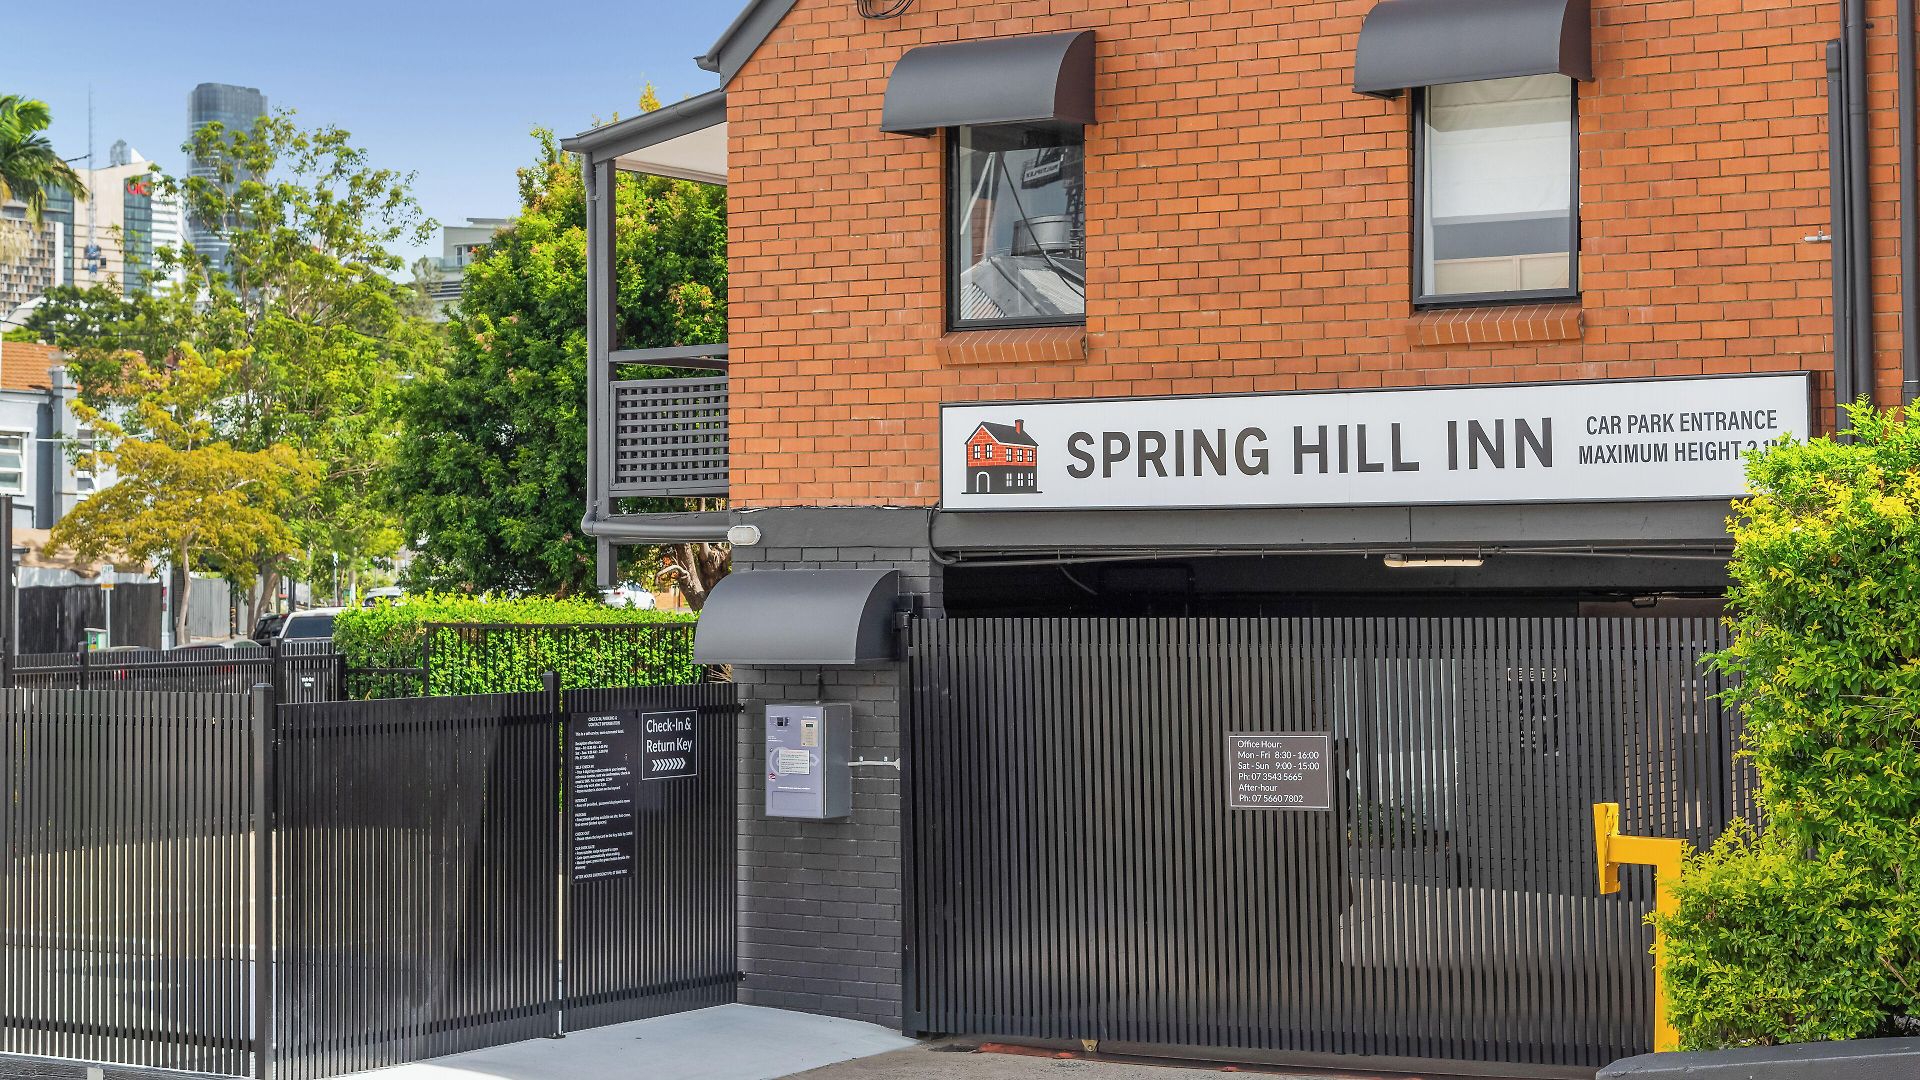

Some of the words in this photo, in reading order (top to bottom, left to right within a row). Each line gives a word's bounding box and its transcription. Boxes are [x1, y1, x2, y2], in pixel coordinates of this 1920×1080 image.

[1586, 415, 1622, 435] CAR
[1627, 413, 1675, 434] PARK
[1679, 409, 1778, 432] ENTRANCE
[1066, 426, 1270, 479] SPRING
[1293, 422, 1420, 475] HILL
[1447, 417, 1553, 471] INN
[1578, 442, 1669, 465] MAXIMUM
[1674, 440, 1742, 462] HEIGHT
[646, 718, 684, 733] Check-In
[684, 717, 692, 731] &
[646, 739, 676, 753] Return
[676, 737, 693, 753] Key
[1237, 739, 1260, 748] Office
[1261, 740, 1282, 749] Hour:
[1237, 751, 1255, 759] Mon
[1260, 751, 1271, 759] Fri
[1274, 751, 1291, 759] 8:30
[1297, 751, 1320, 760] 16:00
[1237, 762, 1250, 770] Sat
[1255, 762, 1270, 770] Sun
[1275, 762, 1292, 770] 9:00
[1298, 762, 1320, 771] 15:00
[1238, 773, 1250, 781] Ph:
[1251, 773, 1262, 781] 07
[1262, 773, 1282, 781] 3543
[1283, 773, 1303, 781] 5665
[1238, 783, 1278, 792] After-hour
[1251, 795, 1262, 803] 07
[1263, 795, 1283, 803] 5660
[1284, 795, 1304, 803] 7802
